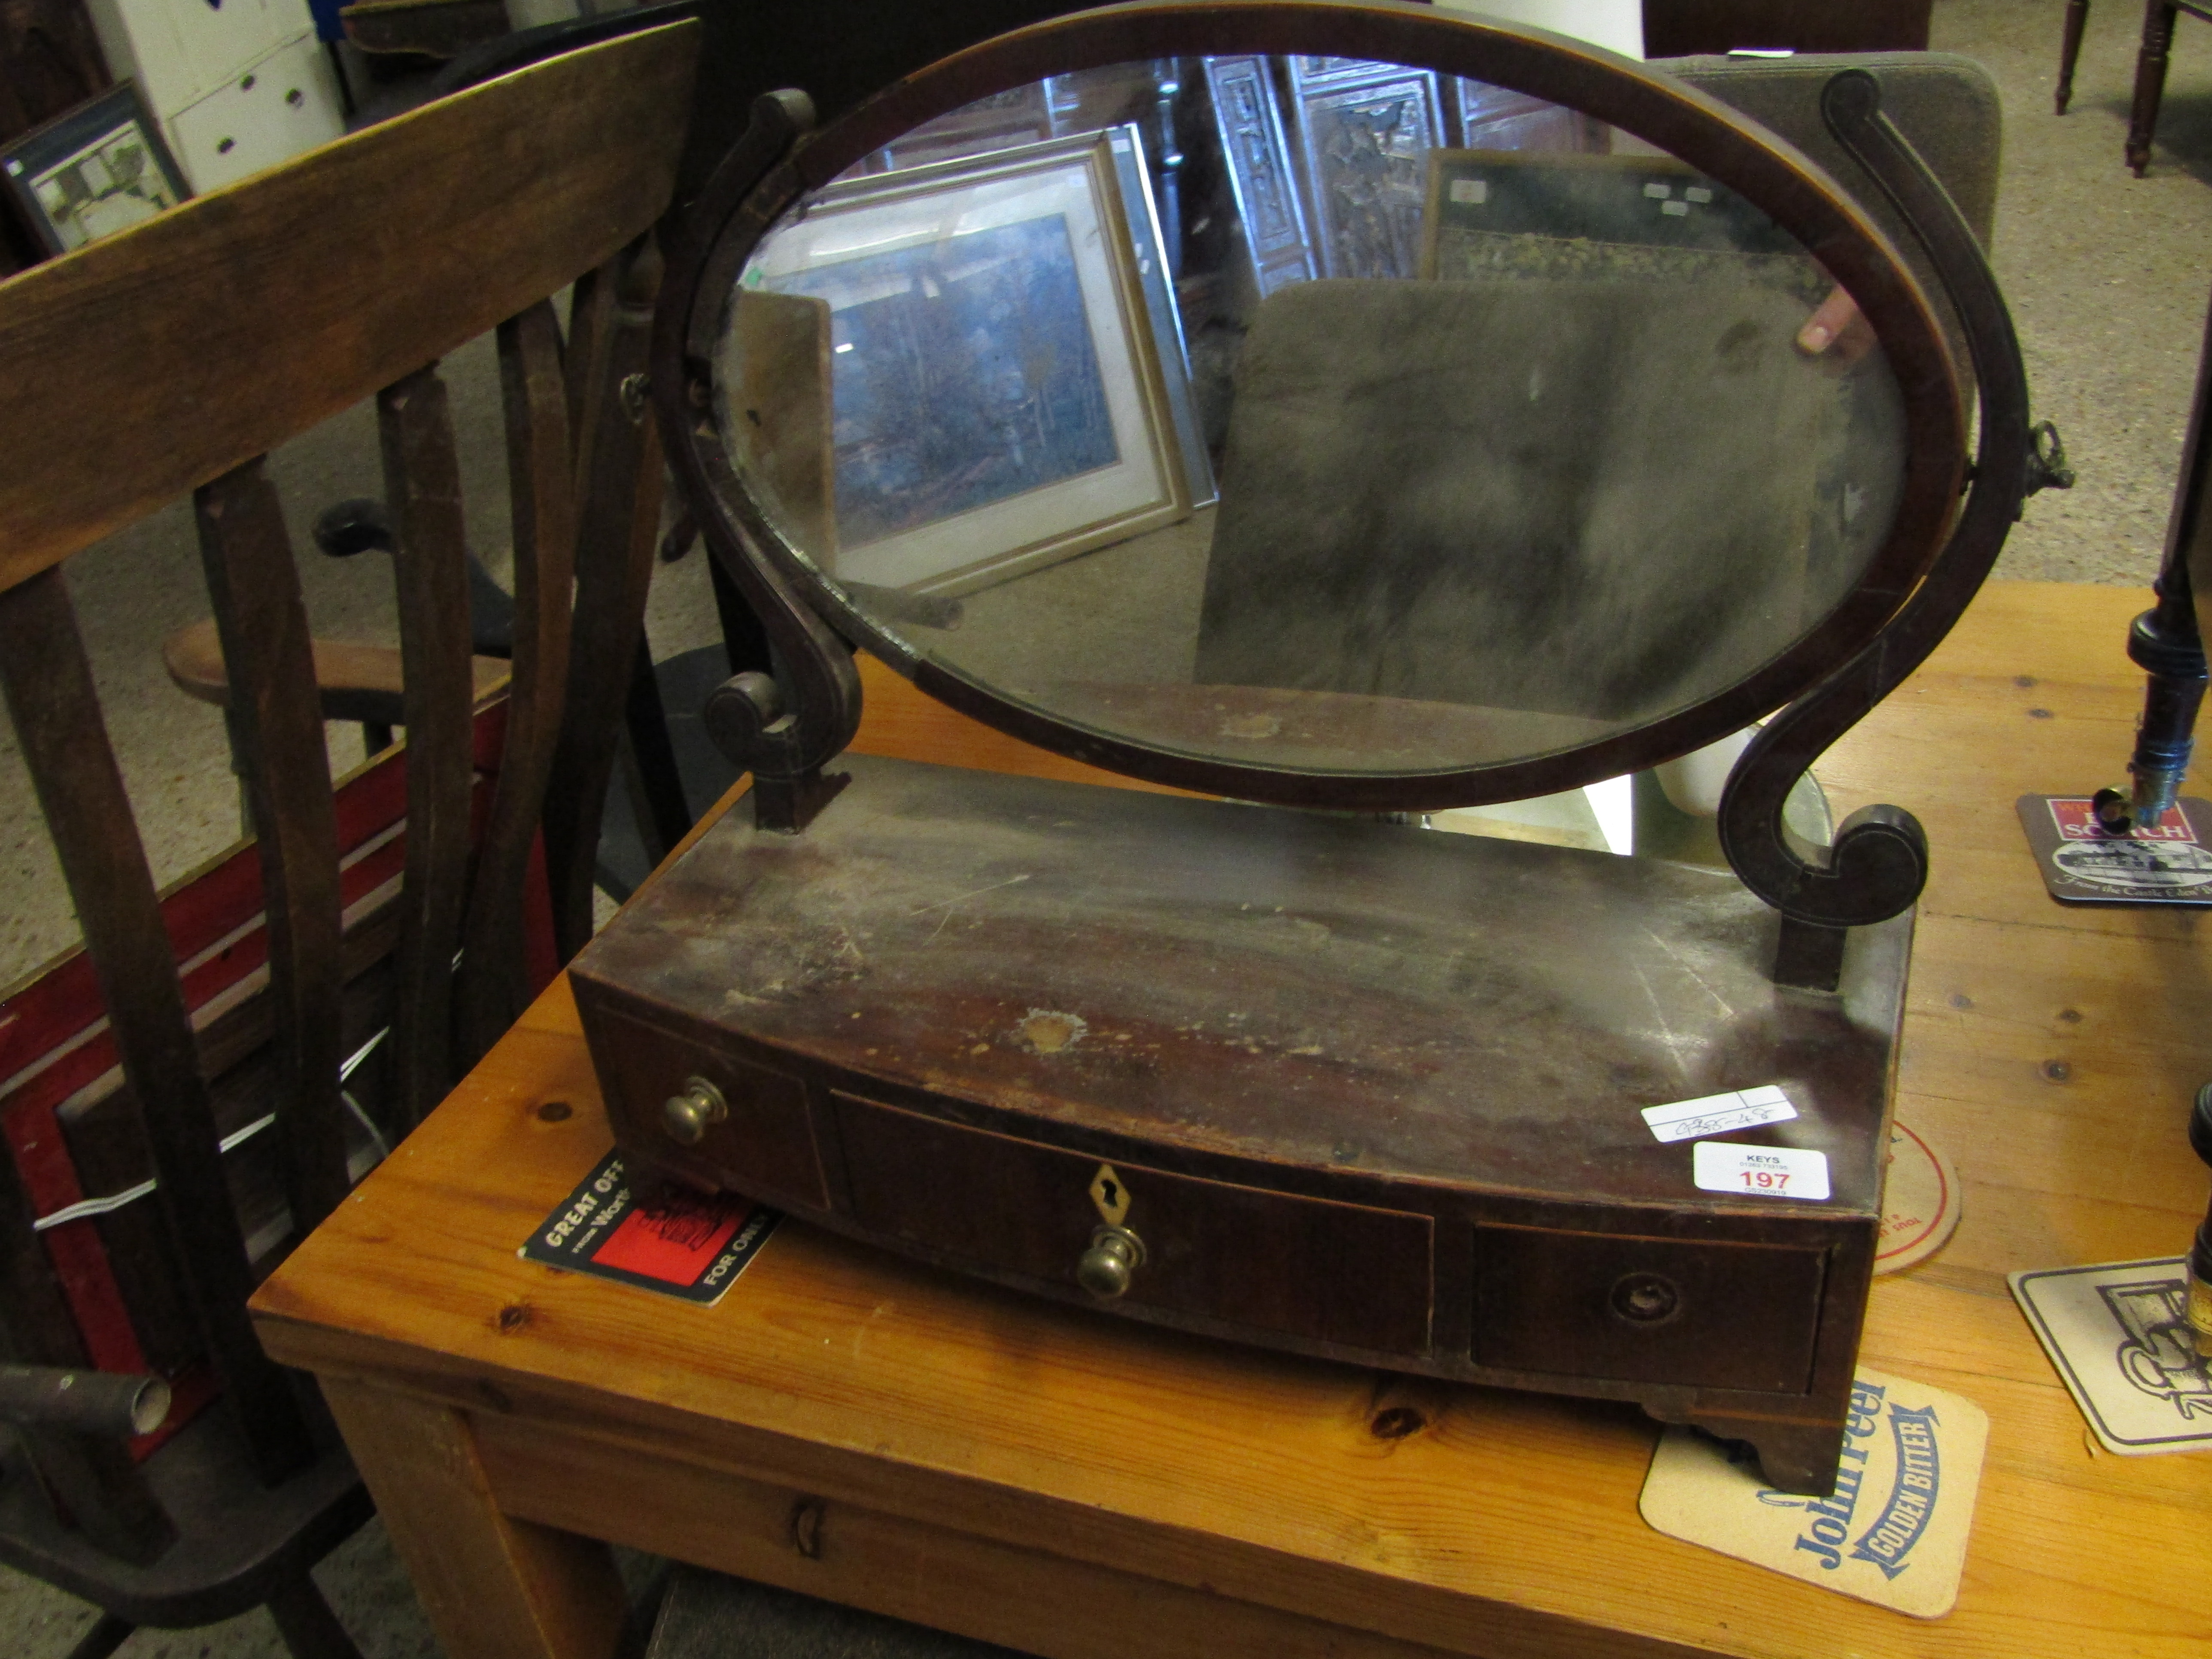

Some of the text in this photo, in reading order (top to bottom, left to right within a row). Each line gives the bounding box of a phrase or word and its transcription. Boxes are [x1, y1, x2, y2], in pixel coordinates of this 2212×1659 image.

[1747, 1155, 1780, 1164] KEYS
[1740, 1171, 1790, 1189] 197
[545, 1191, 599, 1247] GREAT
[703, 1253, 738, 1286] FOR
[1868, 1422, 1933, 1558] GOLDEN BITTER
